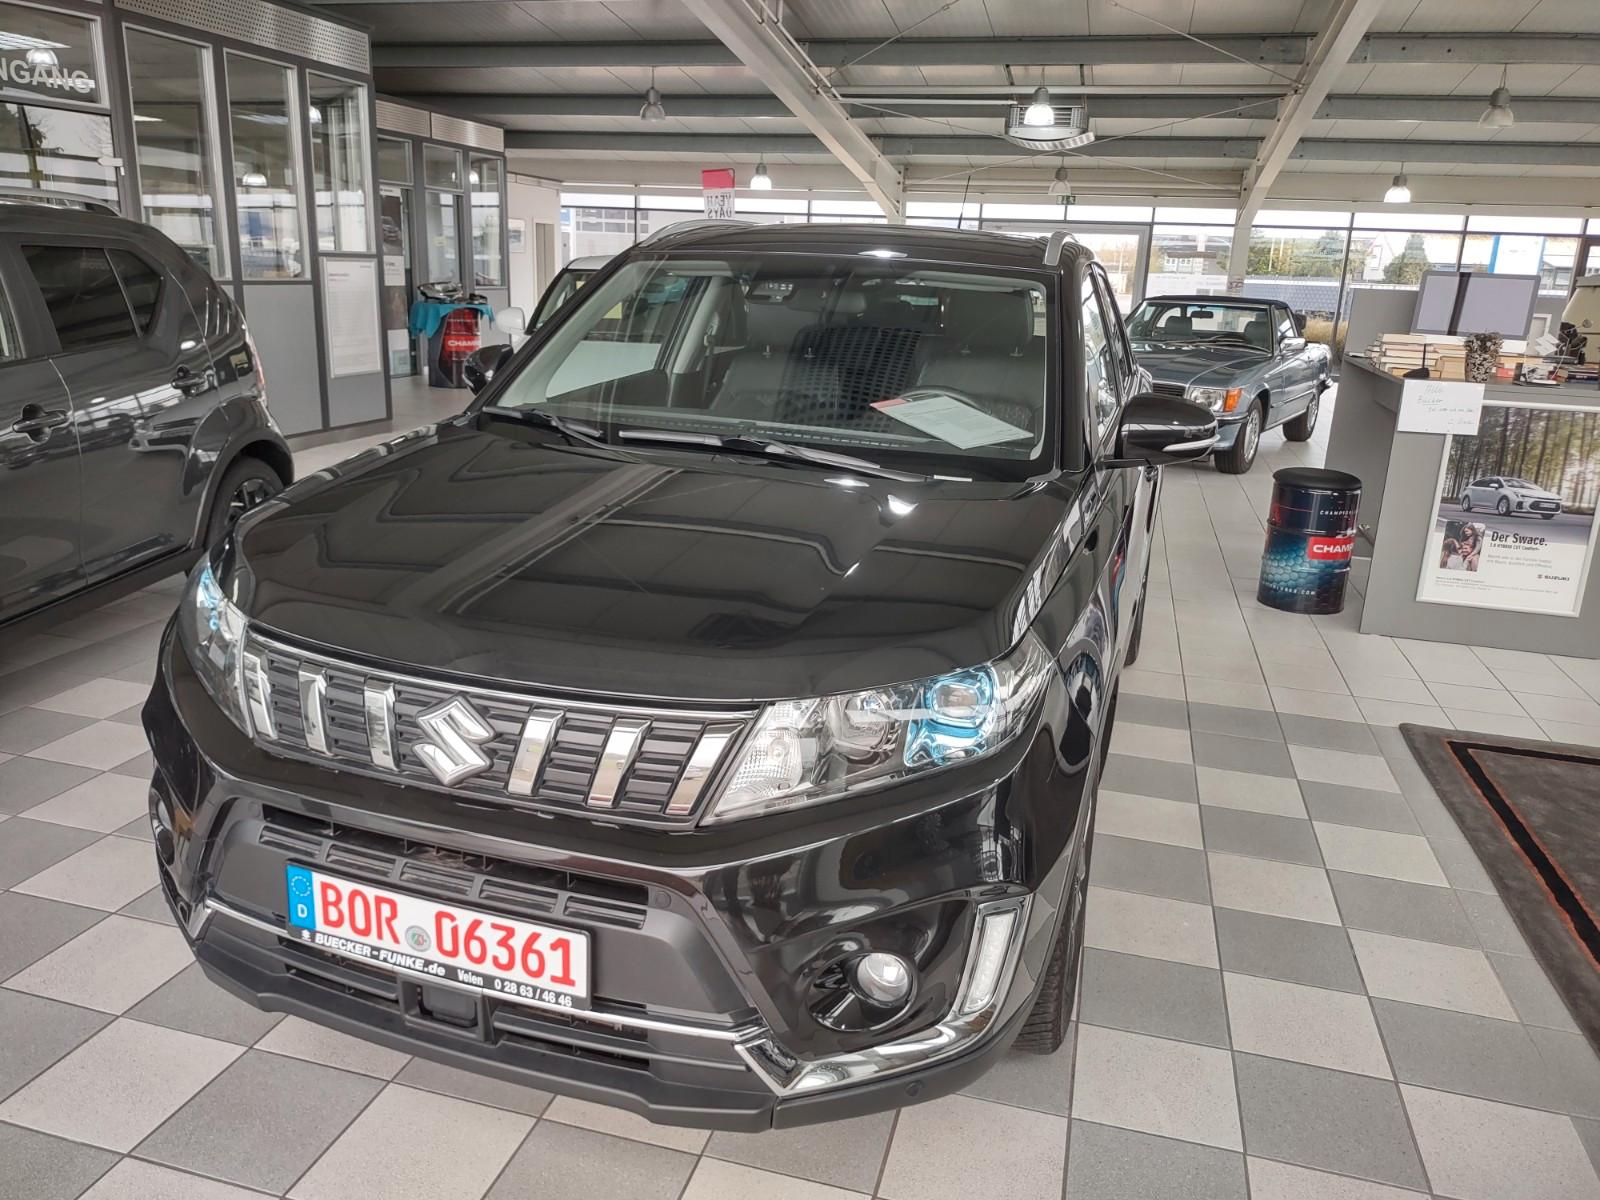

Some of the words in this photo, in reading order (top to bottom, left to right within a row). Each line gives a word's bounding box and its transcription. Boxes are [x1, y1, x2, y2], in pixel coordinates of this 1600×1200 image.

[1491, 531, 1510, 543] Der
[1512, 533, 1548, 547] Swace.
[297, 903, 308, 918] D
[320, 881, 400, 945] BOR
[435, 910, 576, 987] 06361
[315, 932, 446, 976] BUECKER-FUNKE.de
[456, 969, 484, 986] Velen
[503, 981, 518, 994] 28
[519, 985, 534, 998] 63
[541, 991, 556, 1004] 46
[558, 995, 573, 1008] 46
